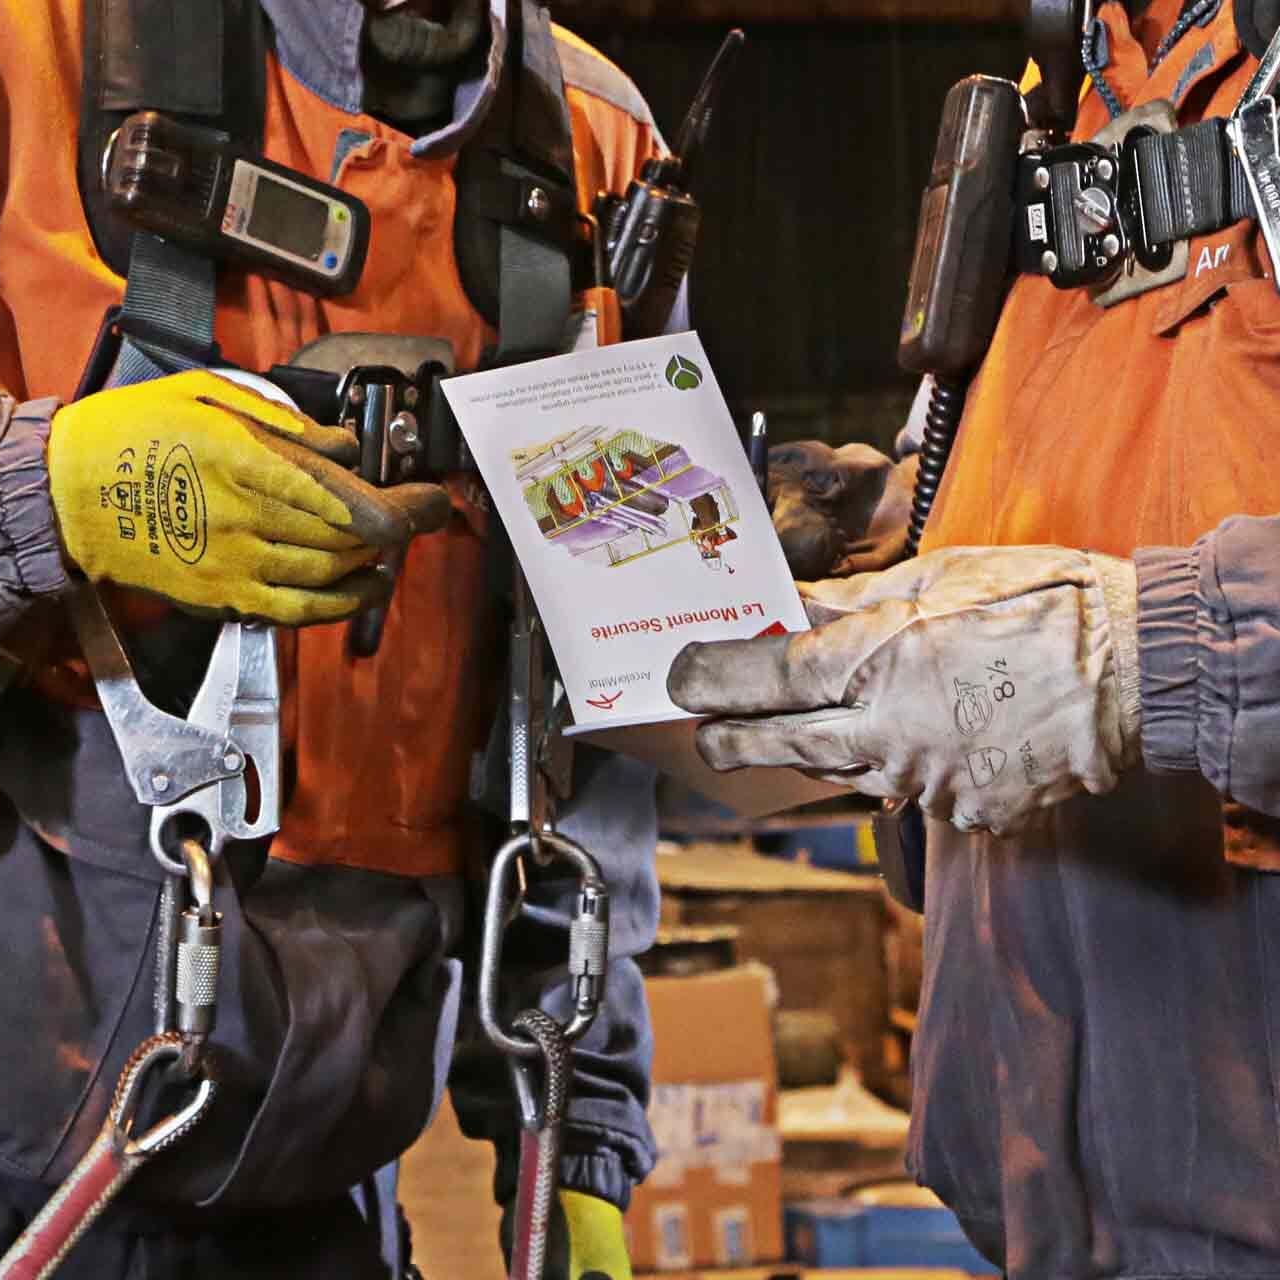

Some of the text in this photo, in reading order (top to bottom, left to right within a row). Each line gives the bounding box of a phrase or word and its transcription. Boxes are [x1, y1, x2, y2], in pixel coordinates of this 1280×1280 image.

[590, 602, 766, 642] Le Moment Sécurité
